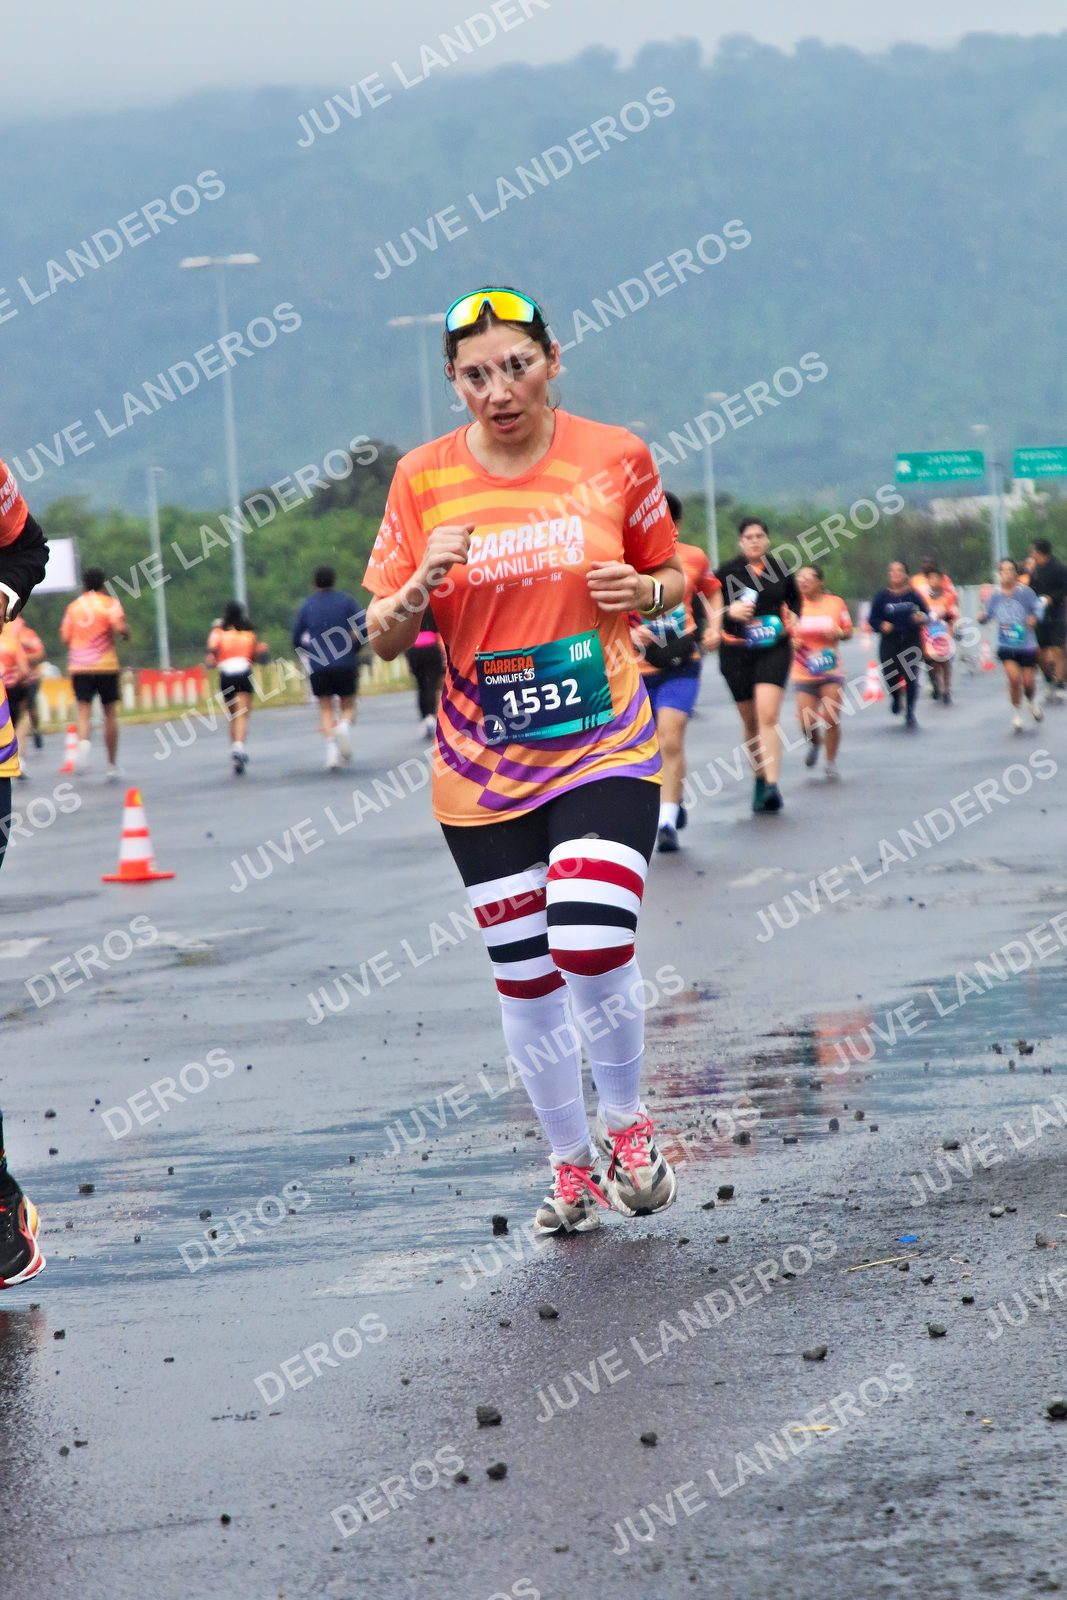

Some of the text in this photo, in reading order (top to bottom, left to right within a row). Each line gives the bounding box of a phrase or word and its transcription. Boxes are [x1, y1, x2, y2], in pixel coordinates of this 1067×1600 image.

[467, 515, 585, 566] CARRERA
[468, 550, 560, 586] OMNILIFE
[483, 656, 534, 675] CARRERA
[569, 639, 593, 663] 10K
[485, 674, 524, 686] OMNILIFE
[502, 678, 582, 716] 1532
